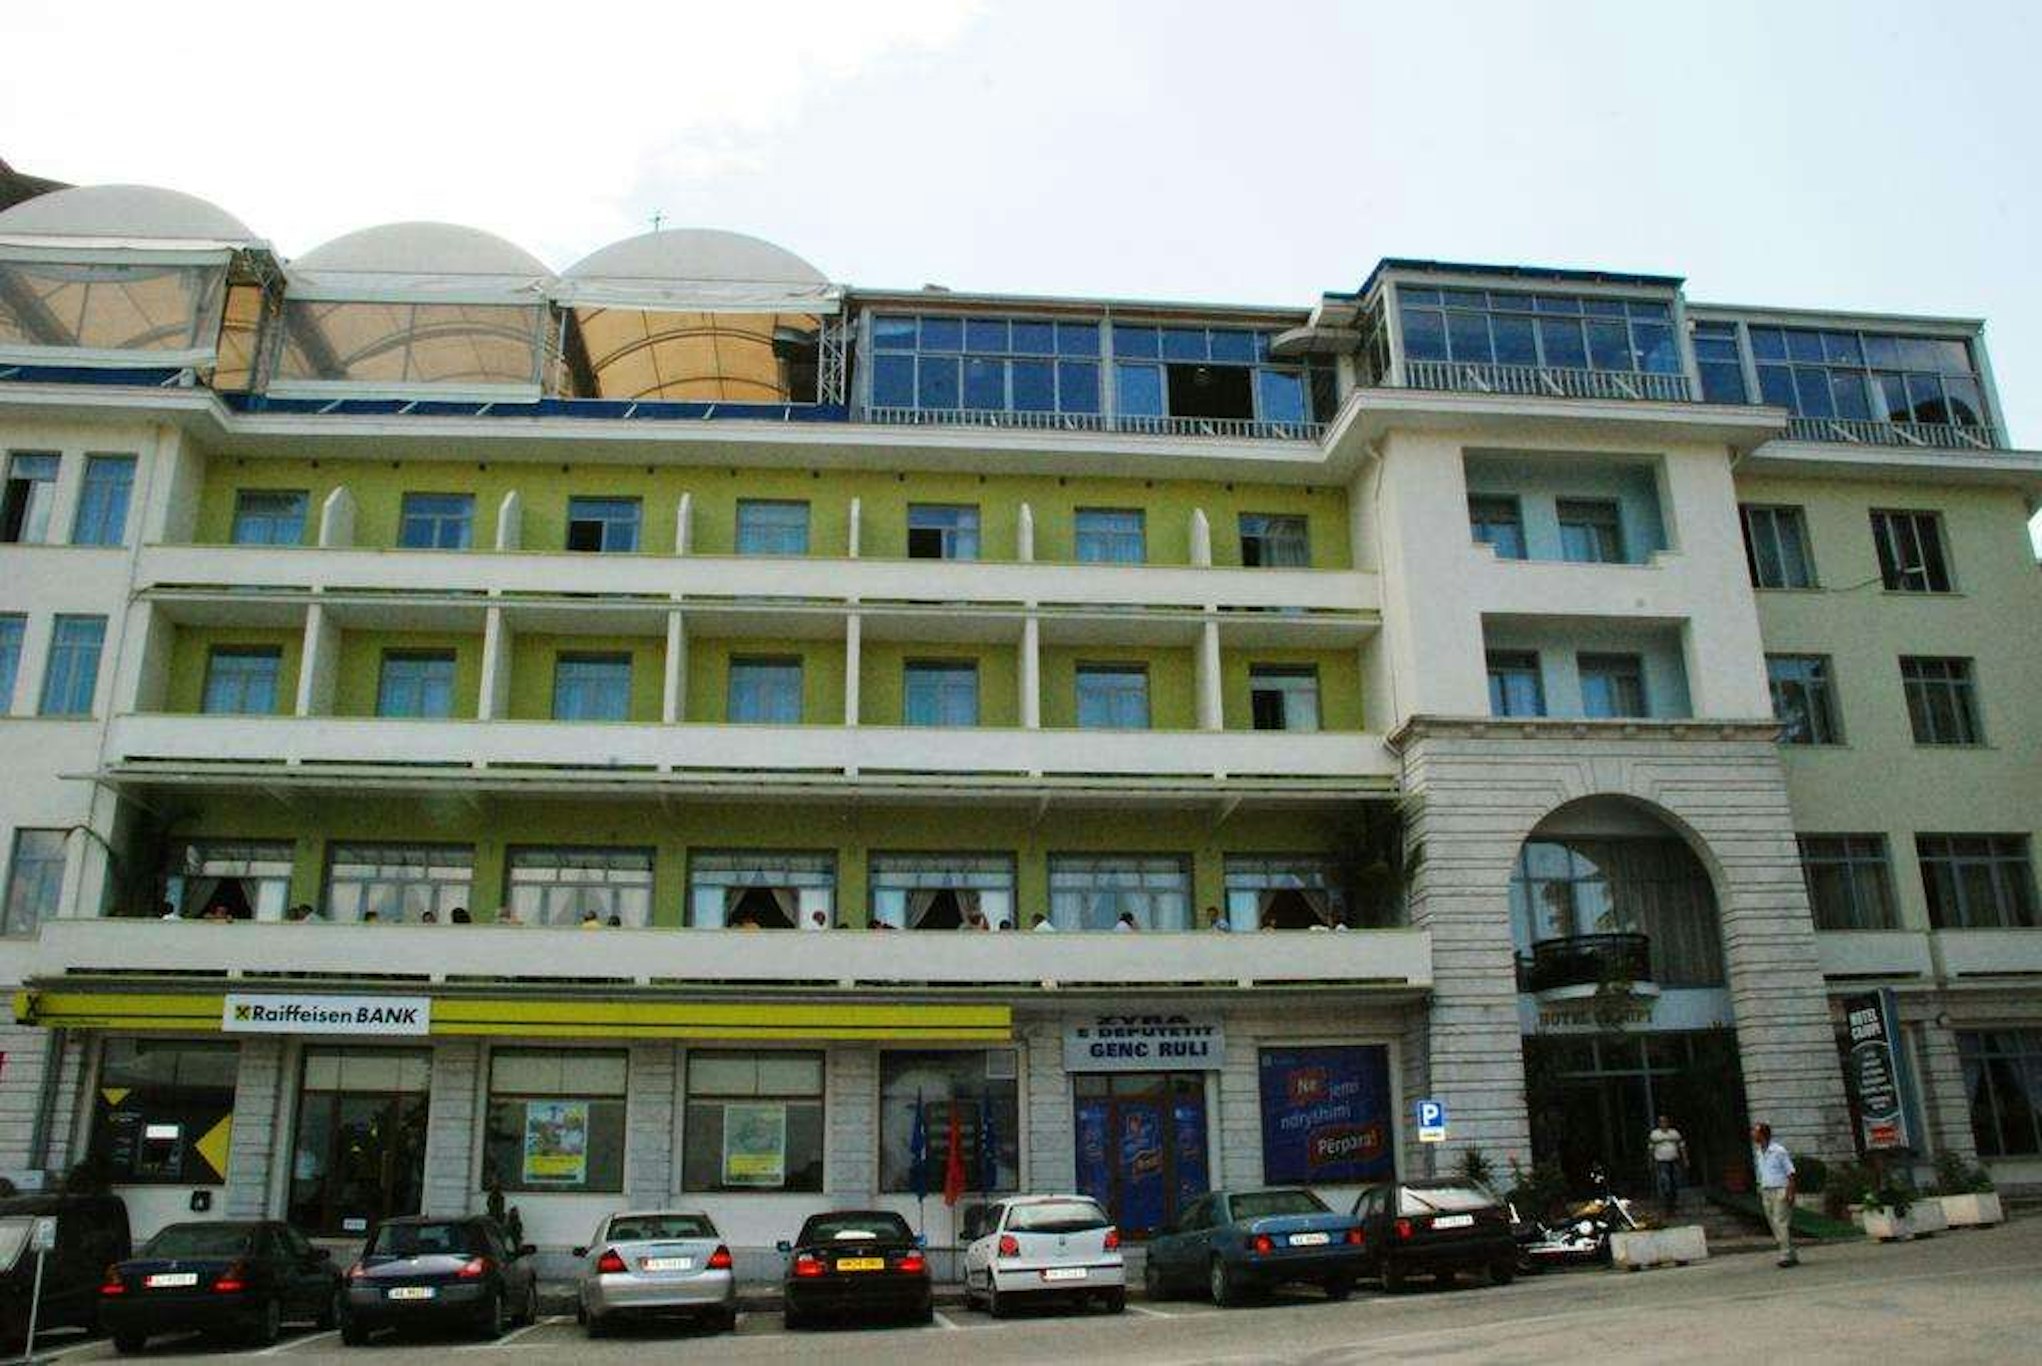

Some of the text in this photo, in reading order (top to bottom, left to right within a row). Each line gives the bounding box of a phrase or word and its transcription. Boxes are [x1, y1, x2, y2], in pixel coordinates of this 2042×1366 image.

[252, 1005, 418, 1024] Raiffeisen BANK
[1090, 1041, 1208, 1058] GENC RULI
[1422, 1103, 1439, 1126] P
